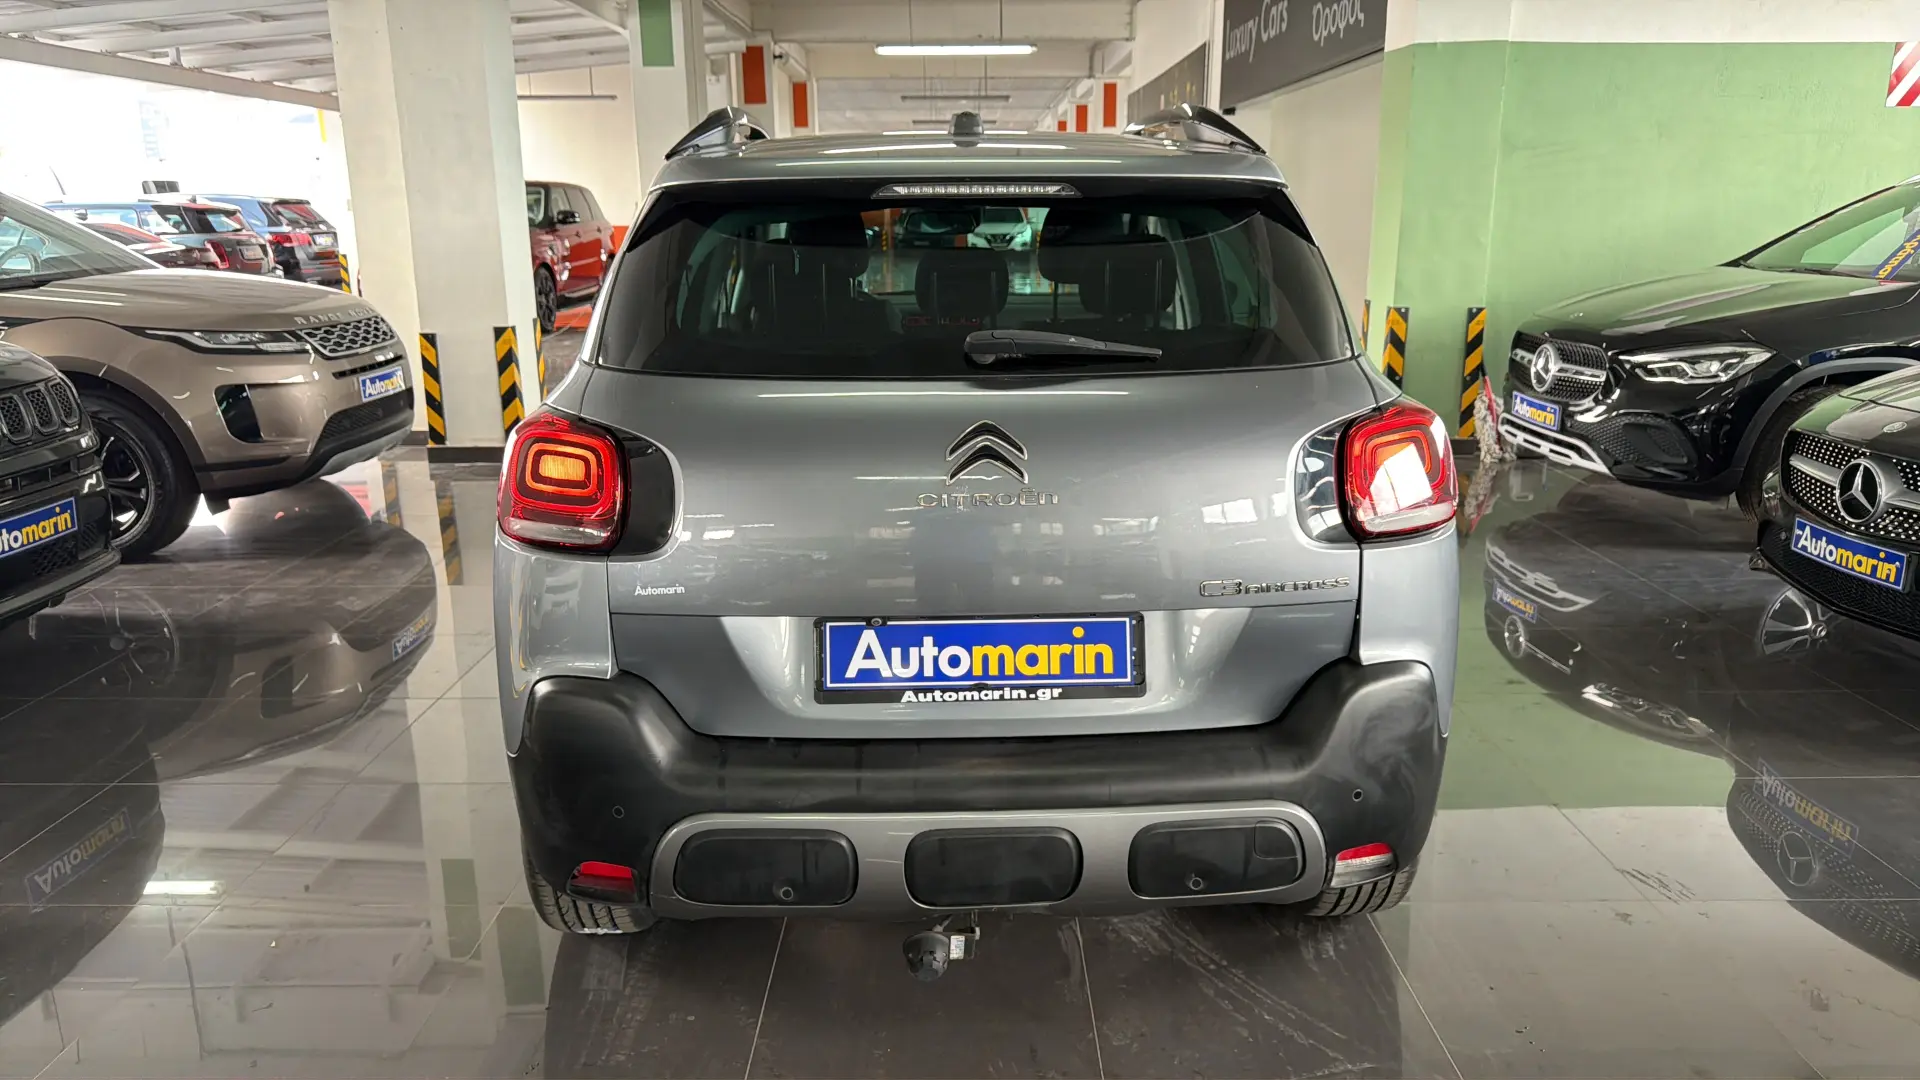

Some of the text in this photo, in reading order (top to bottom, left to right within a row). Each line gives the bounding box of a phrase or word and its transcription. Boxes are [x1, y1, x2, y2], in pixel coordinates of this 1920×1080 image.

[1225, 0, 1288, 63] Luxury Cars
[0, 507, 72, 553] tomarin
[1797, 525, 1897, 583] Automarin
[634, 584, 685, 596] Automarin
[1200, 577, 1350, 597] C3 AIRCROSS
[845, 626, 1114, 678] Automarin
[900, 687, 1063, 703] Automarin.gr
